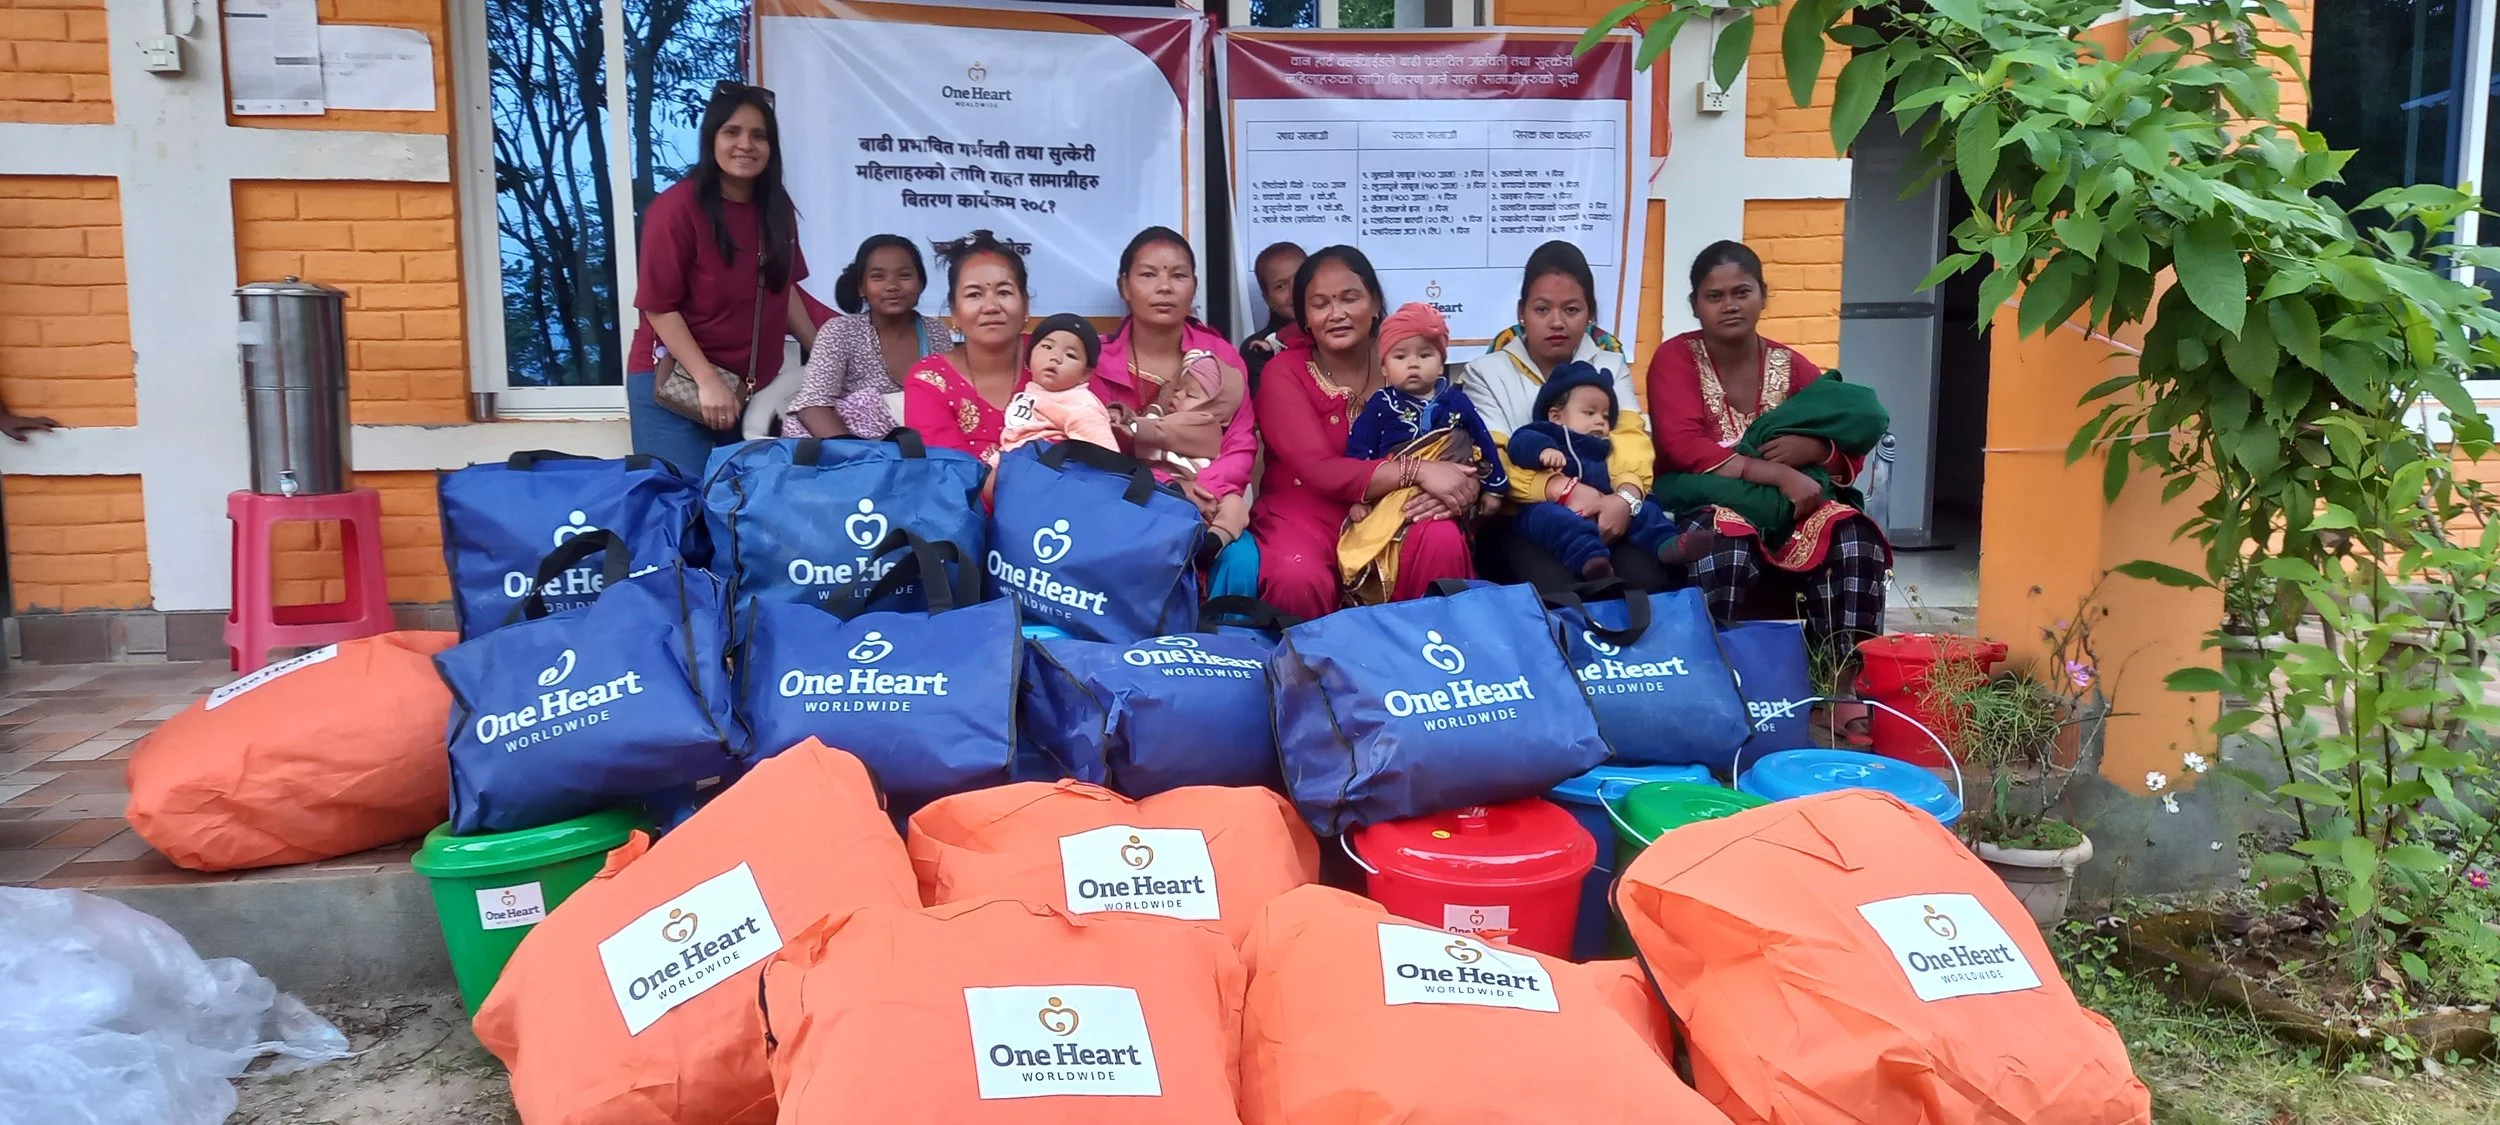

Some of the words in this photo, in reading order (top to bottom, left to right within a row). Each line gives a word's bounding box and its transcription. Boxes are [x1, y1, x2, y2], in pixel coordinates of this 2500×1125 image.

[1511, 56, 1531, 67] तथा
[1356, 72, 1384, 85] लागि
[1451, 73, 1477, 85] राहत
[942, 85, 970, 99] One
[971, 87, 1012, 101] Heart
[858, 134, 893, 153] बाढी
[897, 135, 954, 156] प्रभावित
[958, 139, 1011, 160] गर्भवती
[1014, 145, 1044, 161] तथा
[1048, 142, 1096, 166] सुत्केरी
[855, 160, 946, 182] महिलाहरुको
[950, 164, 986, 184] लागि
[989, 171, 1024, 188] राहत
[1027, 170, 1100, 191] सामाग्रीहरु
[901, 189, 952, 209] बितरण
[1021, 198, 1057, 214] २०८१
[788, 559, 853, 586] One
[987, 550, 1026, 588] One
[1026, 566, 1109, 616] Heart
[1123, 649, 1190, 667] One
[1183, 648, 1264, 670] Heart
[1600, 655, 1689, 680] Heart
[779, 669, 844, 698] One
[846, 668, 949, 697] Heart
[1161, 667, 1252, 679] WORLDWIDE
[1384, 689, 1452, 718] One
[1446, 675, 1536, 710] Heart
[1586, 681, 1666, 696] ORLDWIDE
[476, 706, 538, 744] One
[538, 670, 645, 721] Heart
[804, 700, 911, 713] WORLDWIDE
[1746, 697, 1796, 719] eart
[504, 709, 611, 753] WORLDWIDE
[1423, 707, 1518, 732] WORLDWIDE
[1078, 878, 1130, 899] One
[1131, 875, 1206, 896] Heart
[485, 911, 506, 921] One
[506, 905, 540, 919] Heart
[1104, 899, 1183, 911] WORLDWIDE
[628, 961, 682, 1001] One
[678, 916, 761, 971] Heart
[1907, 951, 1957, 973] One
[1948, 943, 2016, 967] Heart
[657, 950, 740, 1001] WORLDWIDE
[1396, 963, 1454, 982] One
[1456, 966, 1541, 992] Heart
[1940, 969, 2005, 984] WORLDWIDE
[1425, 985, 1515, 998] WORLDWIDE
[989, 1043, 1050, 1067] One
[1052, 1043, 1142, 1066] Heart
[1021, 1071, 1116, 1082] WORLDWIDE
